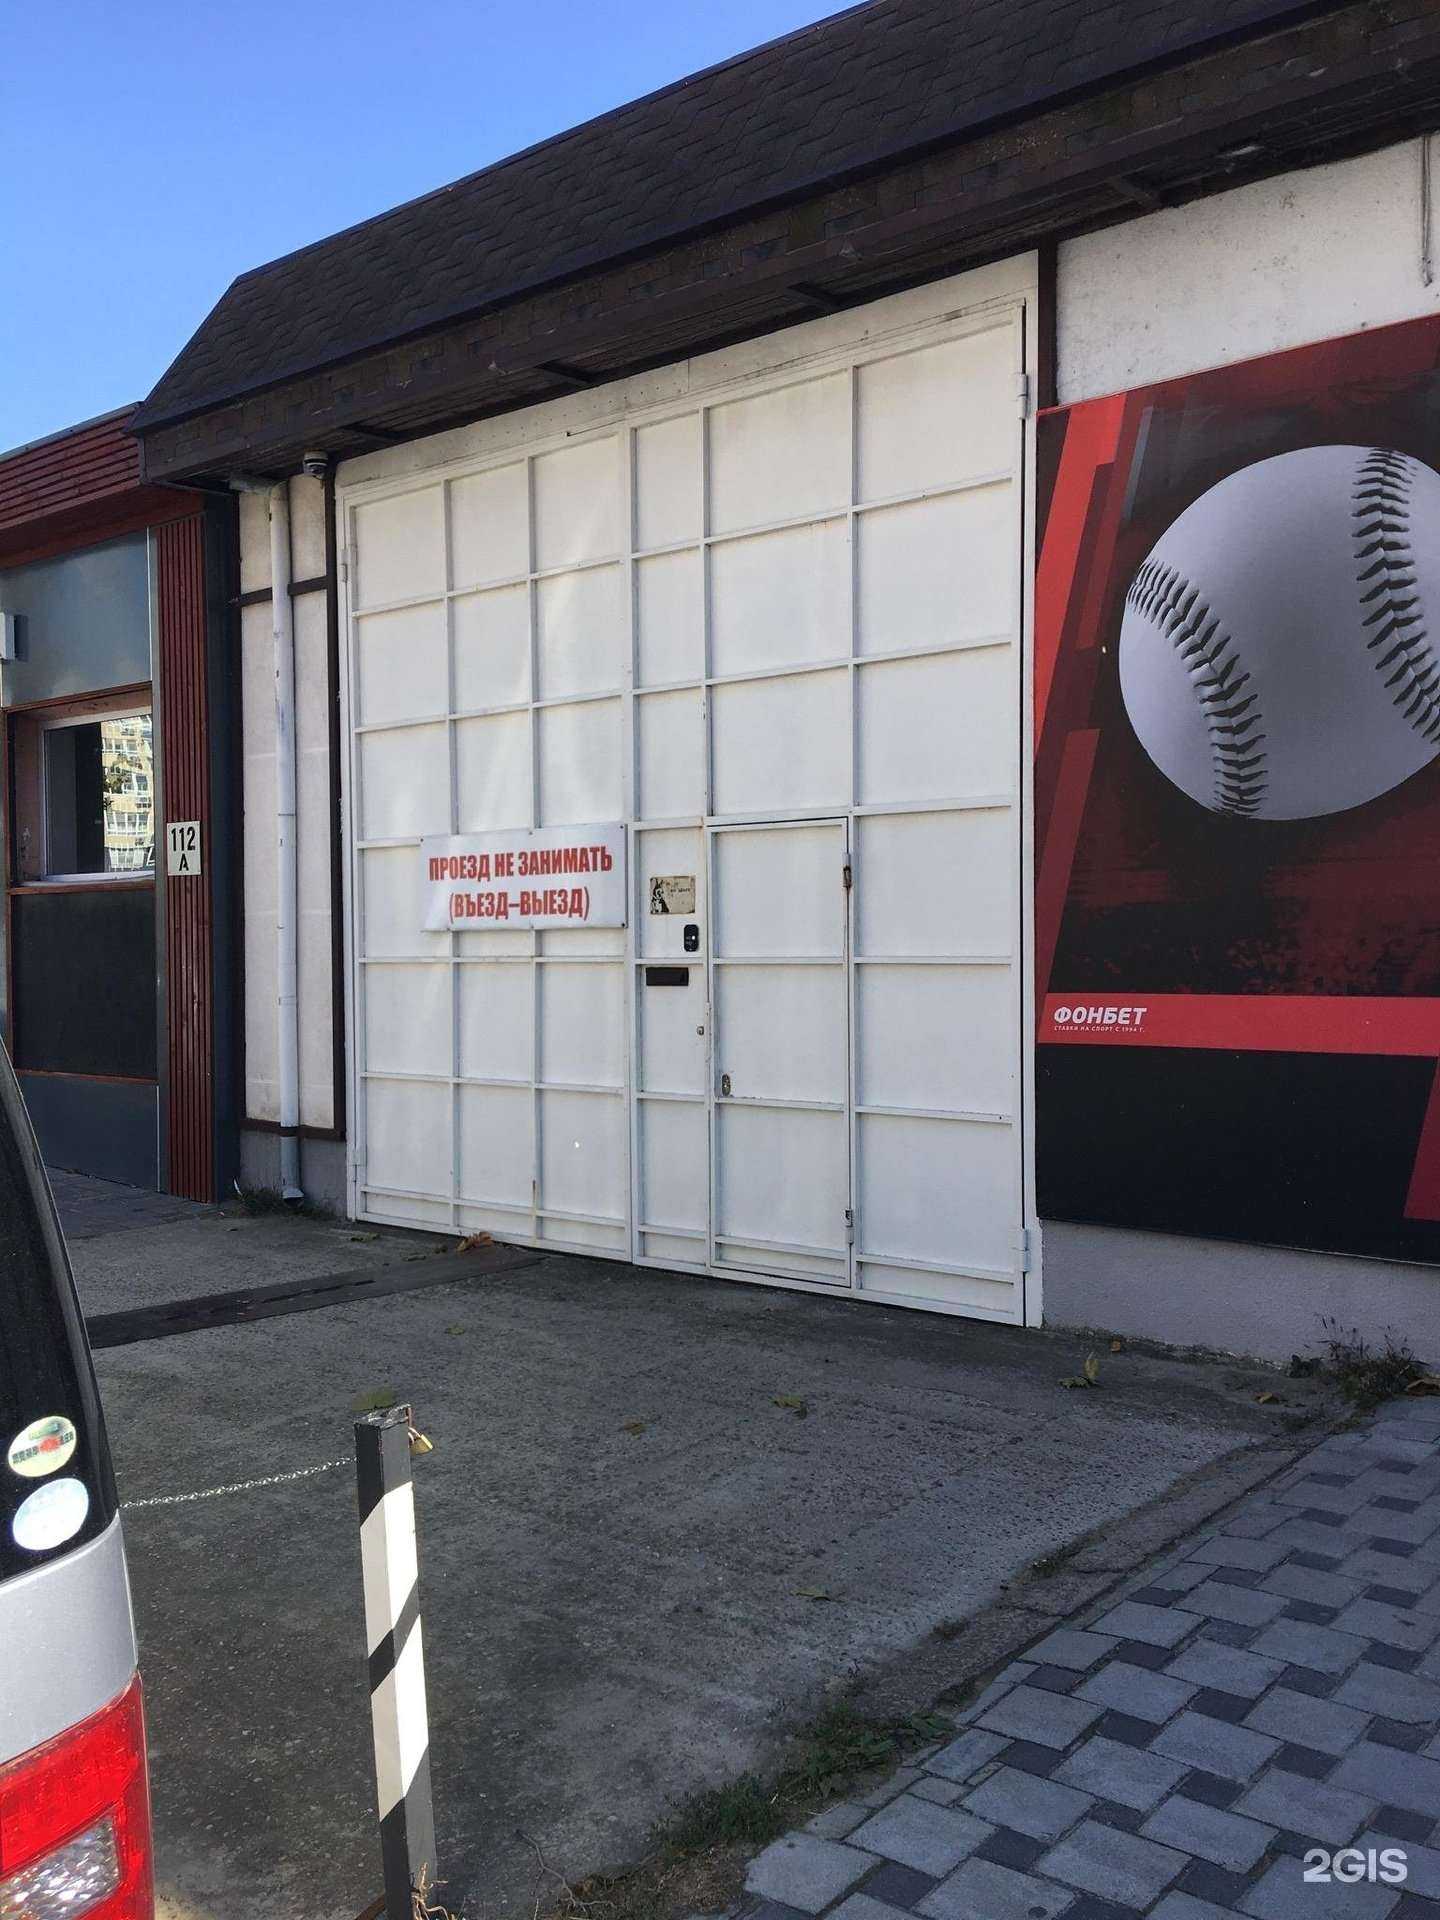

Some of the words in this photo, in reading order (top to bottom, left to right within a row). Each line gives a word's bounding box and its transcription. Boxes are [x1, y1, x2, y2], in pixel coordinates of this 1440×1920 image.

[171, 826, 196, 852] 112
[429, 854, 491, 882] ПРОЕЗД
[495, 852, 514, 877] НЕ
[518, 846, 613, 875] ЗАНИМАТЬ
[1054, 1006, 1147, 1025] ФОНБЕТ
